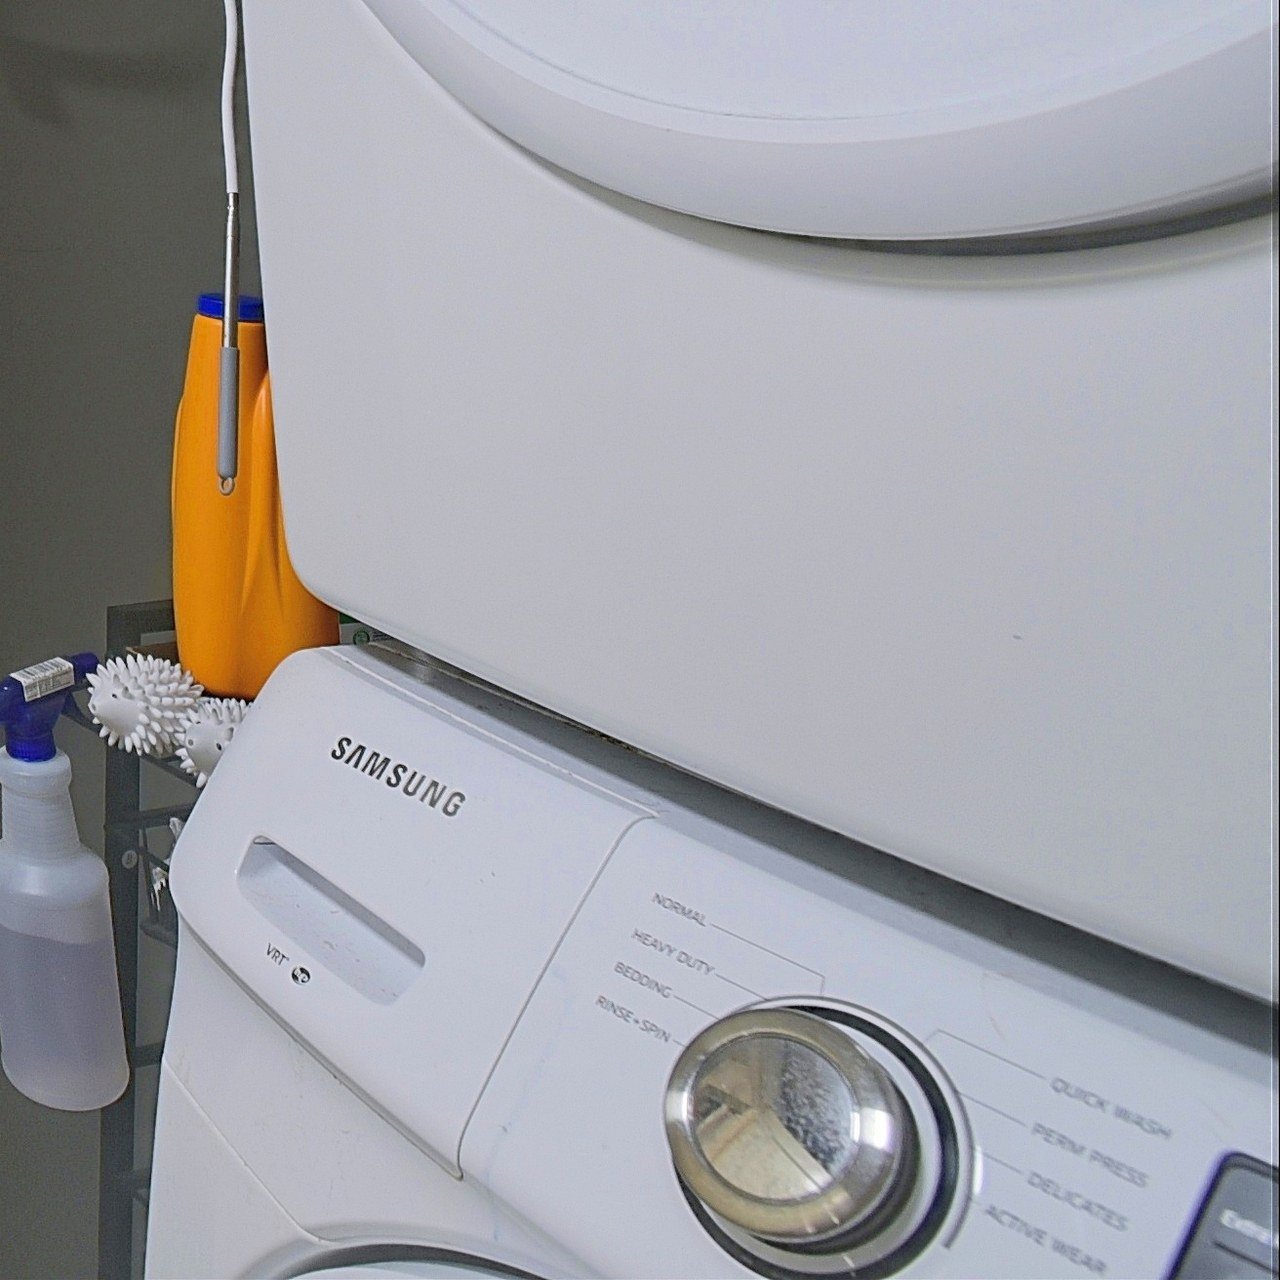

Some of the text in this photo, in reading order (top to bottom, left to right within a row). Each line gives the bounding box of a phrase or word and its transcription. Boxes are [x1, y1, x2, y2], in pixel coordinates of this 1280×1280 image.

[331, 736, 467, 818] SAMSUNG
[651, 892, 707, 928] NORMAL
[613, 961, 673, 999] BEDDING
[631, 928, 716, 976] HEAVY DUTY
[1050, 1076, 1173, 1141] QUICK WASH
[1031, 1122, 1150, 1189] PERM PRESS
[1026, 1170, 1130, 1233] DELICATES
[985, 1204, 1108, 1277] ACTIVE WEAR
